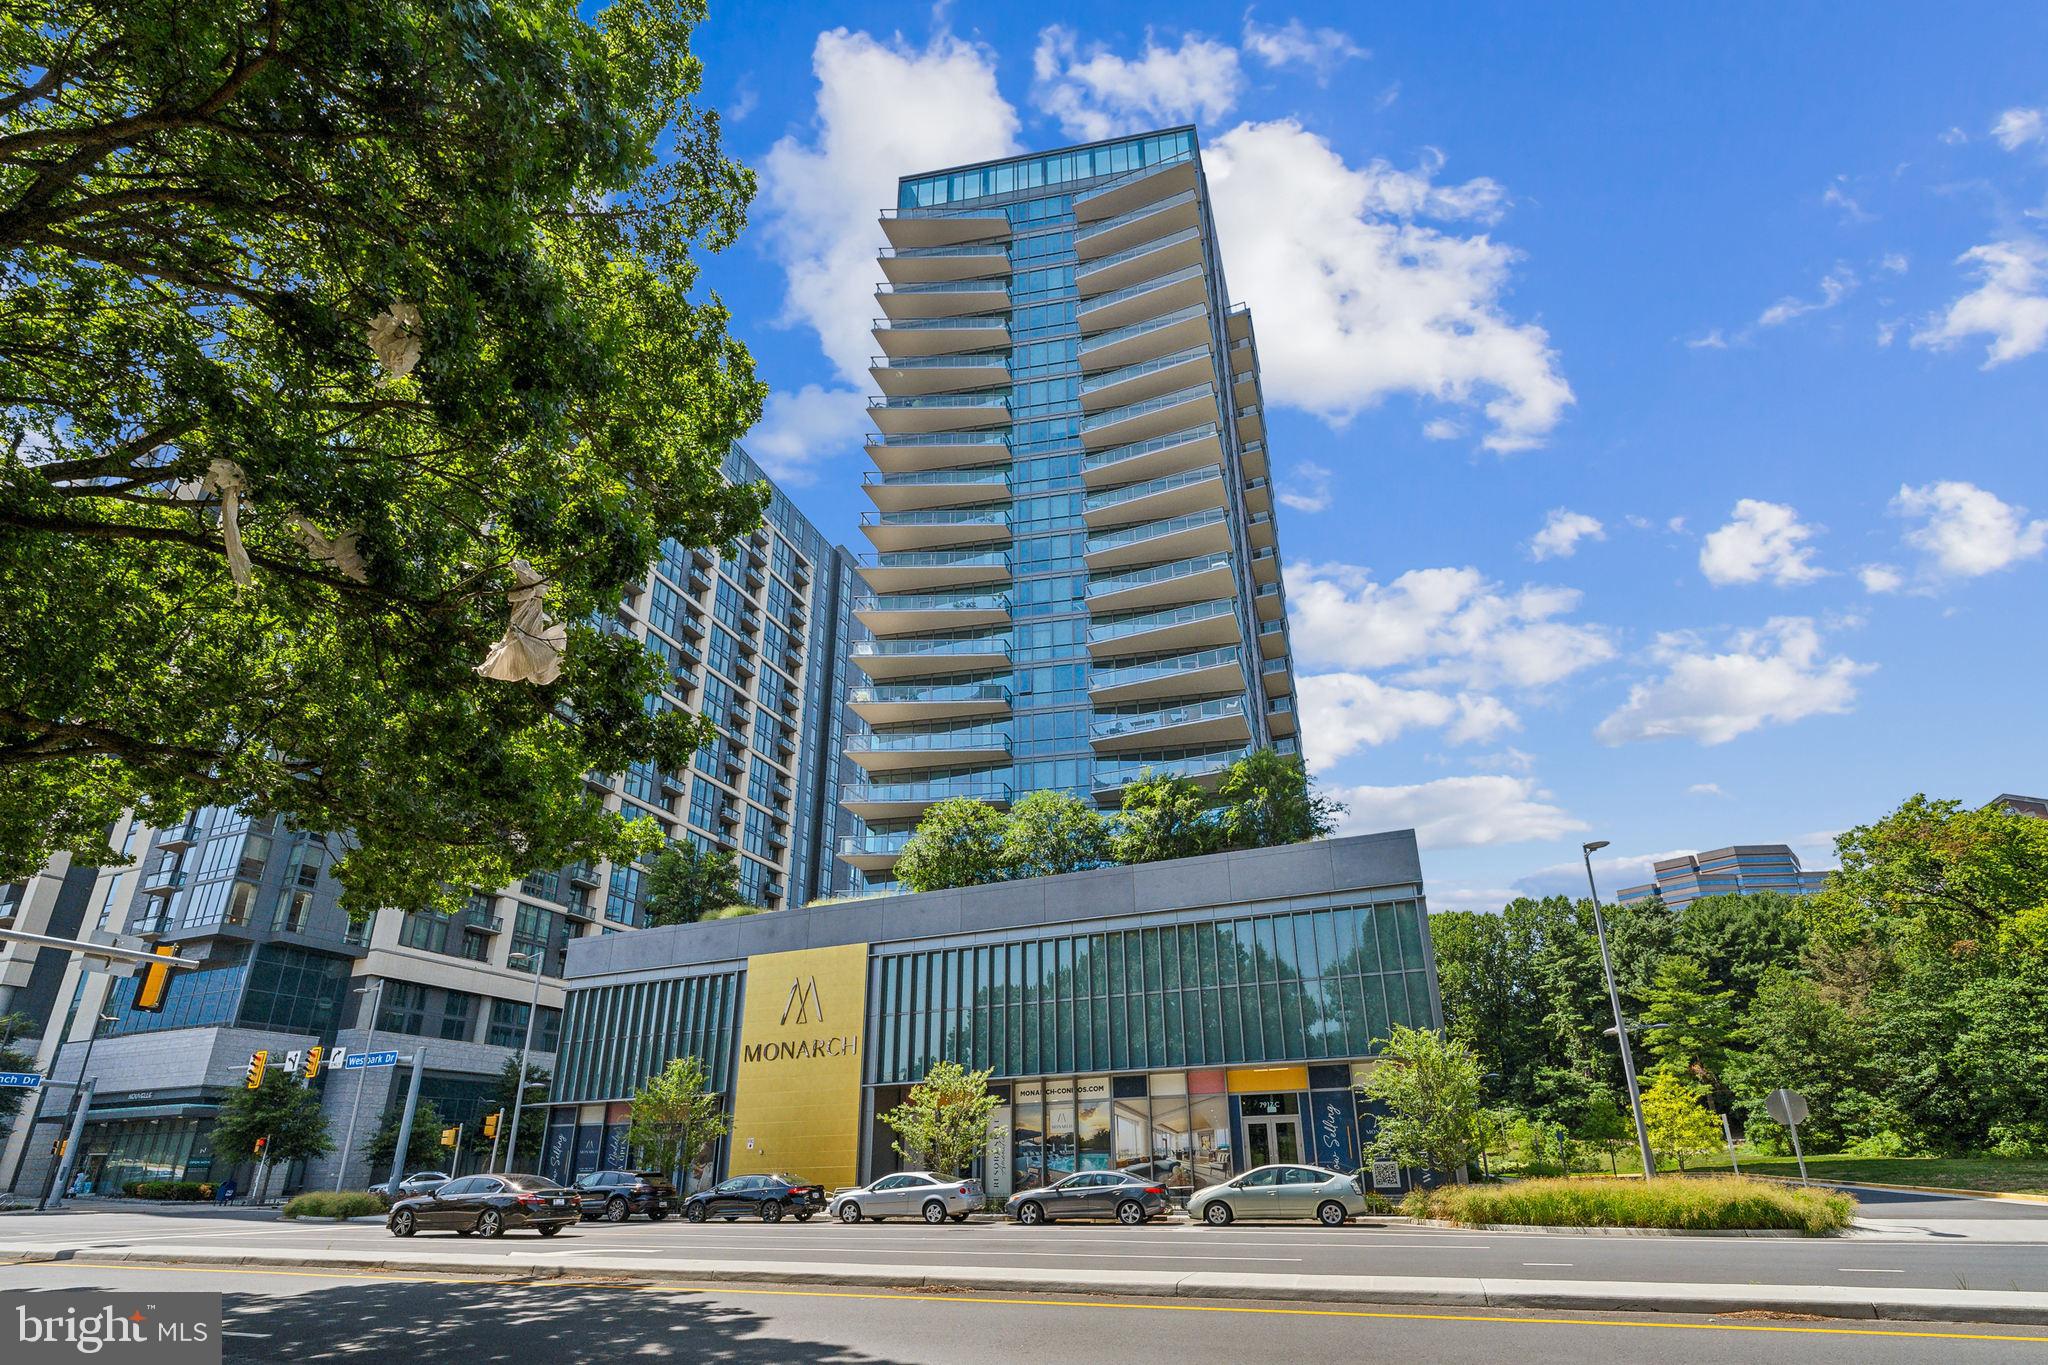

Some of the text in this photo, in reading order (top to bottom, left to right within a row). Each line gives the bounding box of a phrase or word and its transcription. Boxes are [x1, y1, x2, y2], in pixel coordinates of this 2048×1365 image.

[744, 1035, 858, 1063] MONARCH
[349, 1054, 395, 1066] Wespark Dr
[22, 1076, 37, 1085] Dr
[1020, 1085, 1105, 1097] MONACH-CONOS.COM
[1322, 1103, 1341, 1148] Selling
[551, 1134, 567, 1166] Selling
